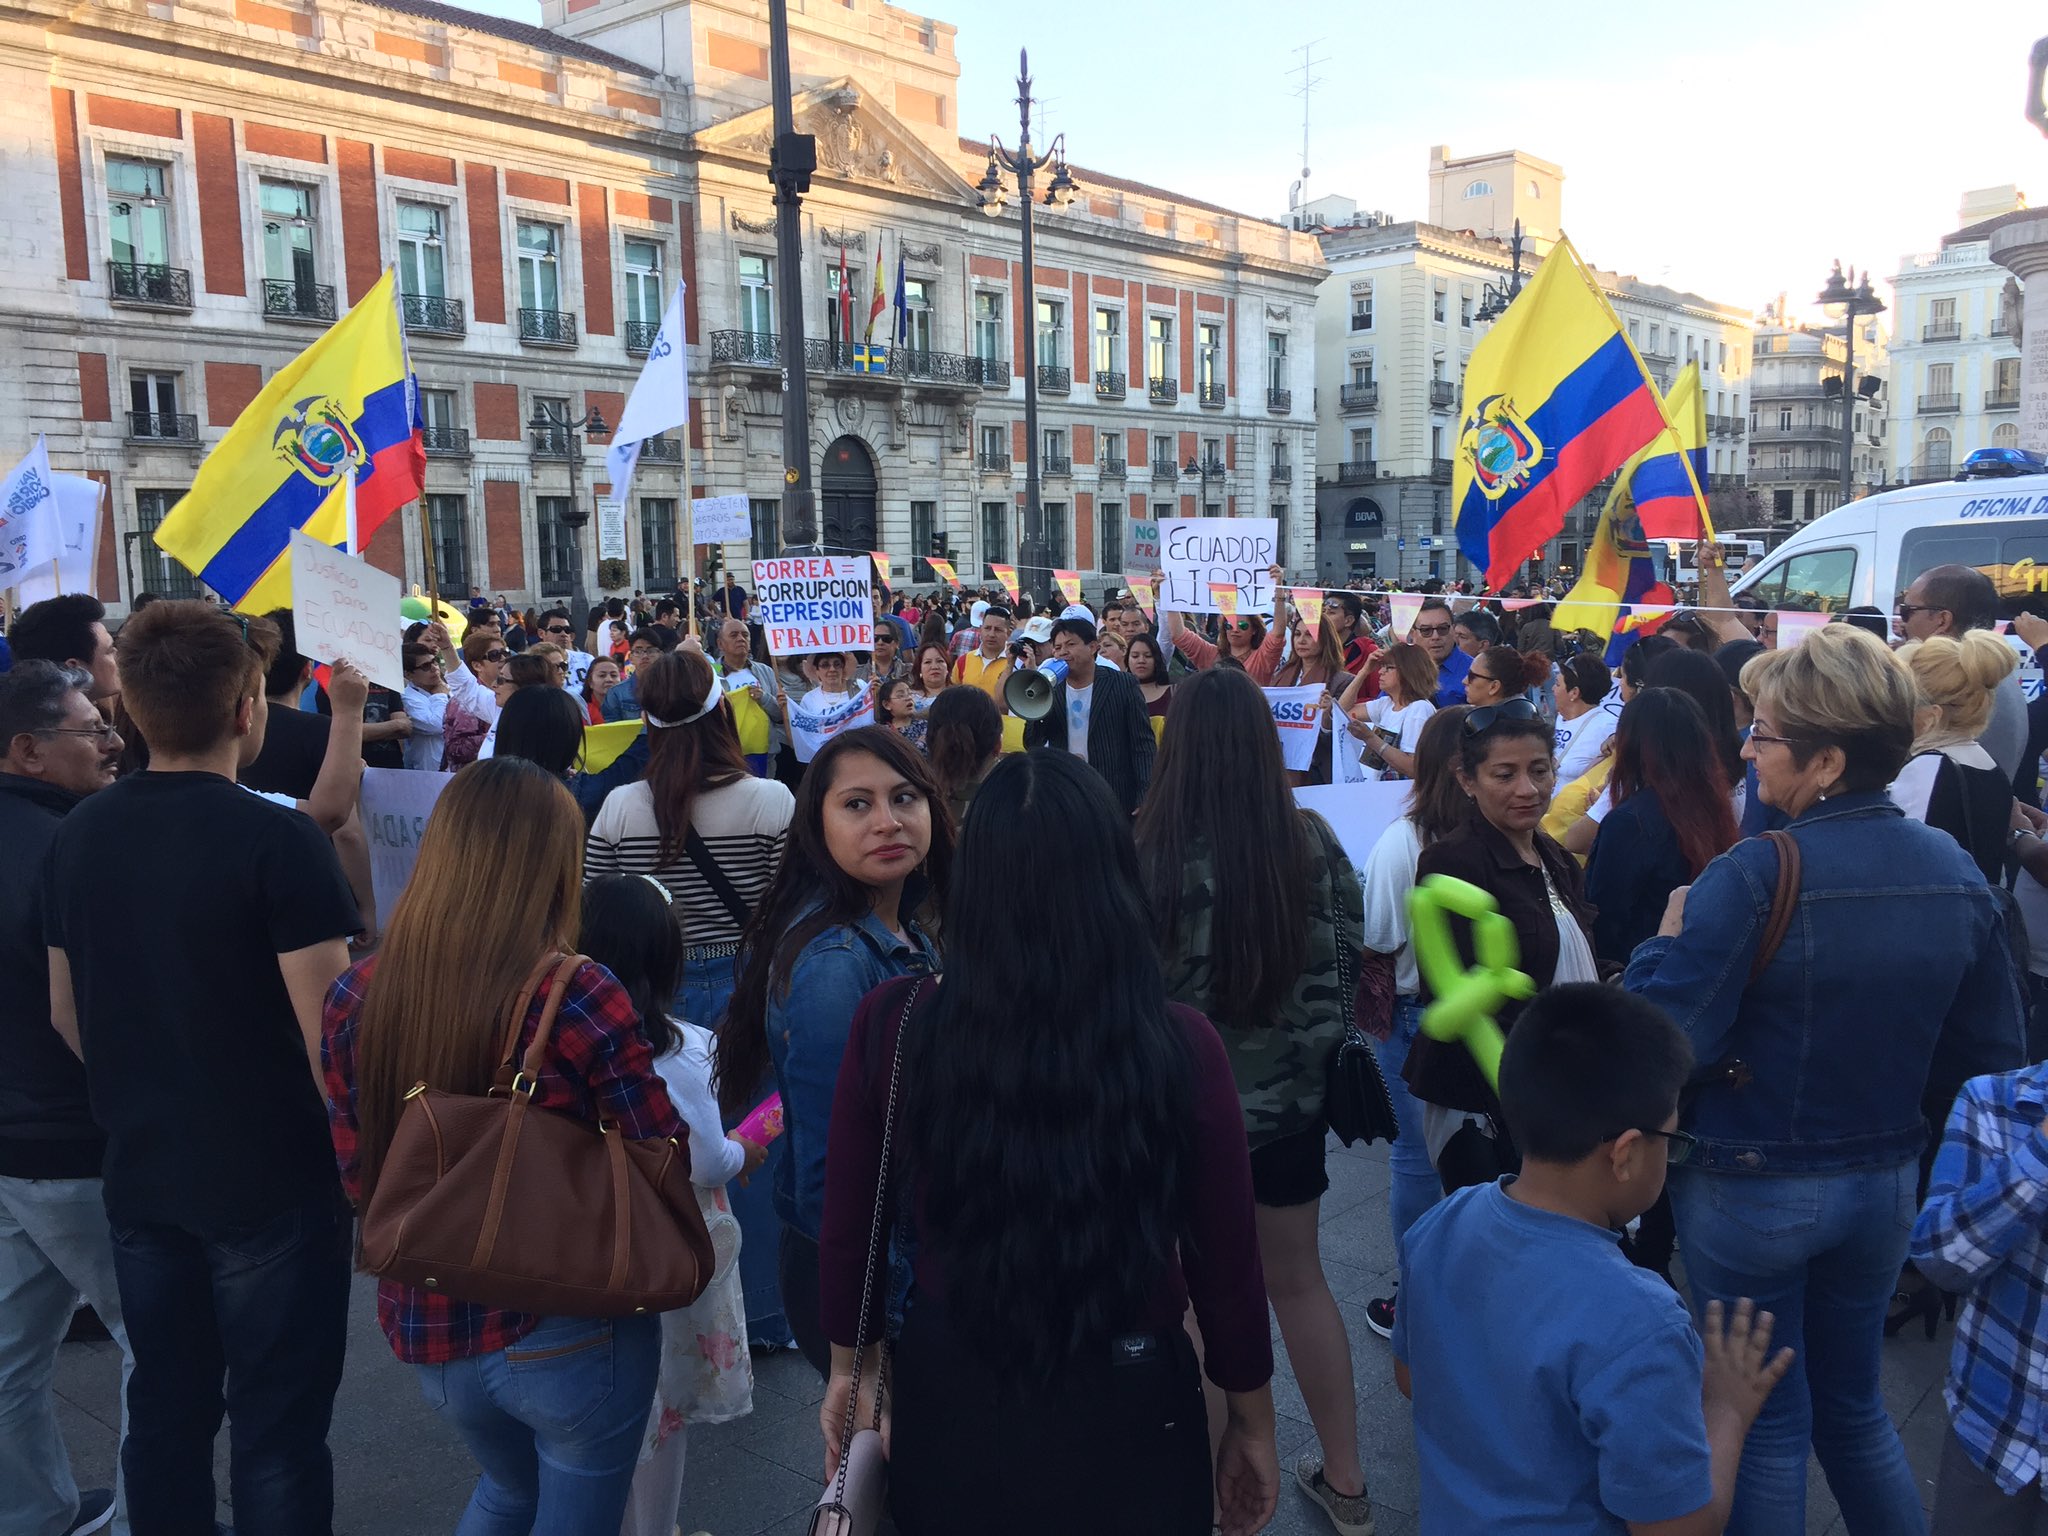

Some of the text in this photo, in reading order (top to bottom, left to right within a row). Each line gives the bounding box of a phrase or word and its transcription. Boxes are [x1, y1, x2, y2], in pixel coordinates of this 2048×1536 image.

[1351, 281, 1372, 291] HOSTAL
[1350, 350, 1371, 359] HOSTAL
[1355, 511, 1377, 521] BBVA
[1960, 497, 2032, 519] OFICINA
[1135, 525, 1157, 540] NO
[1168, 525, 1272, 565] ECUADOR
[754, 559, 835, 581] CORREA
[757, 577, 869, 603] CORRUPCIÓN
[761, 597, 863, 624] REPRESIÓN
[304, 599, 399, 662] ECUADOR
[771, 624, 872, 650] FRAUDE
[1271, 701, 1317, 722] ASSO
